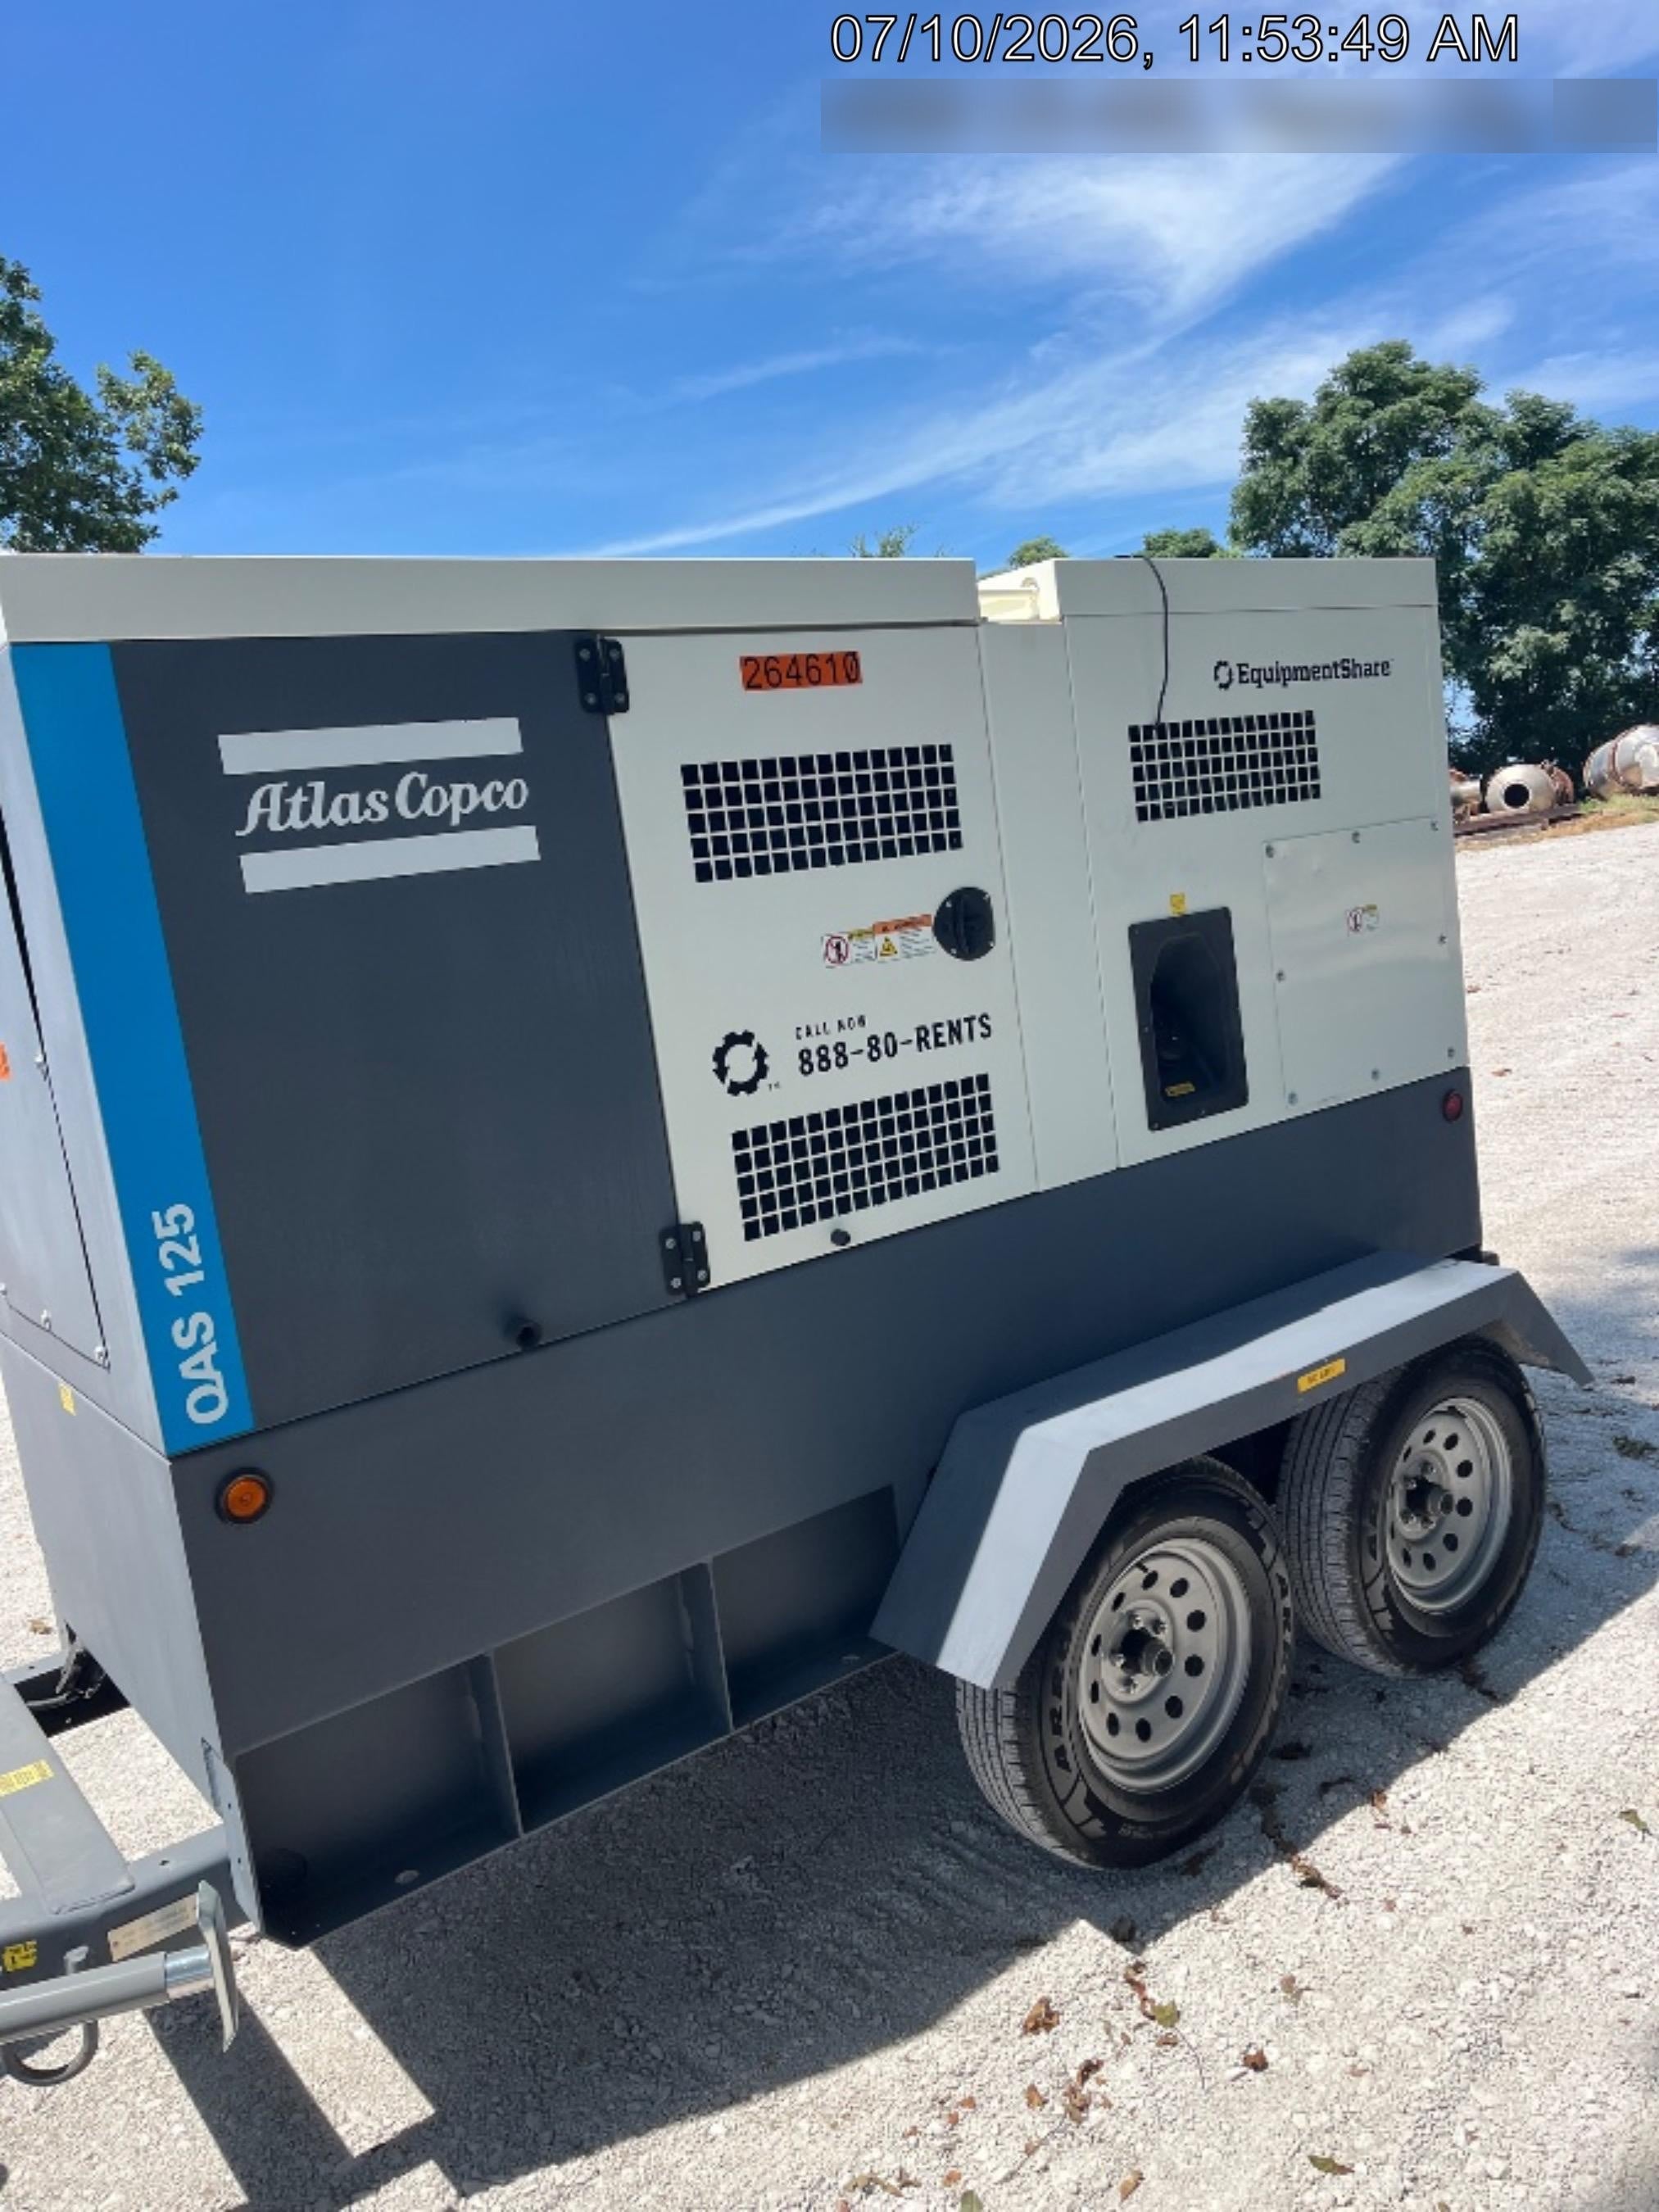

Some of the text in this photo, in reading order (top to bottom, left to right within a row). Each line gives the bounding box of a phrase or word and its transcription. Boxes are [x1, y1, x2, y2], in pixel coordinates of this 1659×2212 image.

[743, 652, 860, 688] 264610
[1236, 659, 1391, 689] EquipmentShare
[235, 771, 528, 836] Atlas Copco
[796, 1014, 866, 1040] CALL NOW
[798, 1013, 993, 1077] 888-80-RENTS
[152, 1203, 229, 1424] QAS 125
